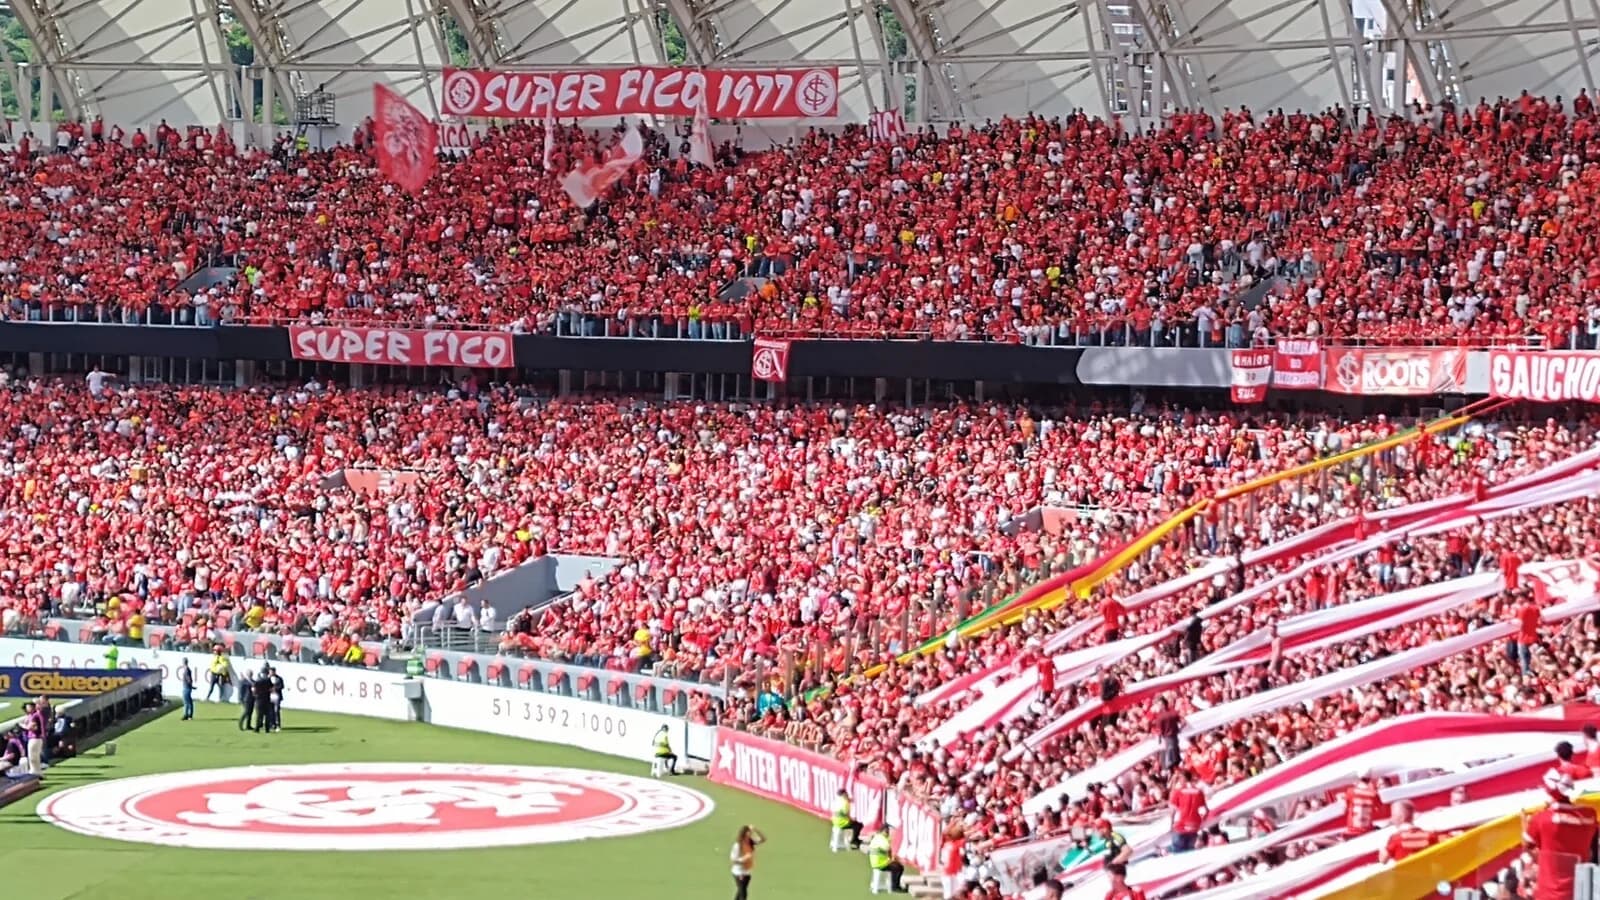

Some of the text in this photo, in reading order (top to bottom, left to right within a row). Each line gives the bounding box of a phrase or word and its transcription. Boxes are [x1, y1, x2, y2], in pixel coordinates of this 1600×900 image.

[484, 69, 793, 117] SUPER FICO 1977
[441, 123, 471, 148] ICO
[296, 330, 506, 366] SUPER FICO
[1362, 358, 1431, 387] ROOTS
[1493, 355, 1600, 400] GAUCHO
[493, 698, 511, 716] 51
[736, 742, 778, 793] INTER
[779, 756, 811, 803] POR
